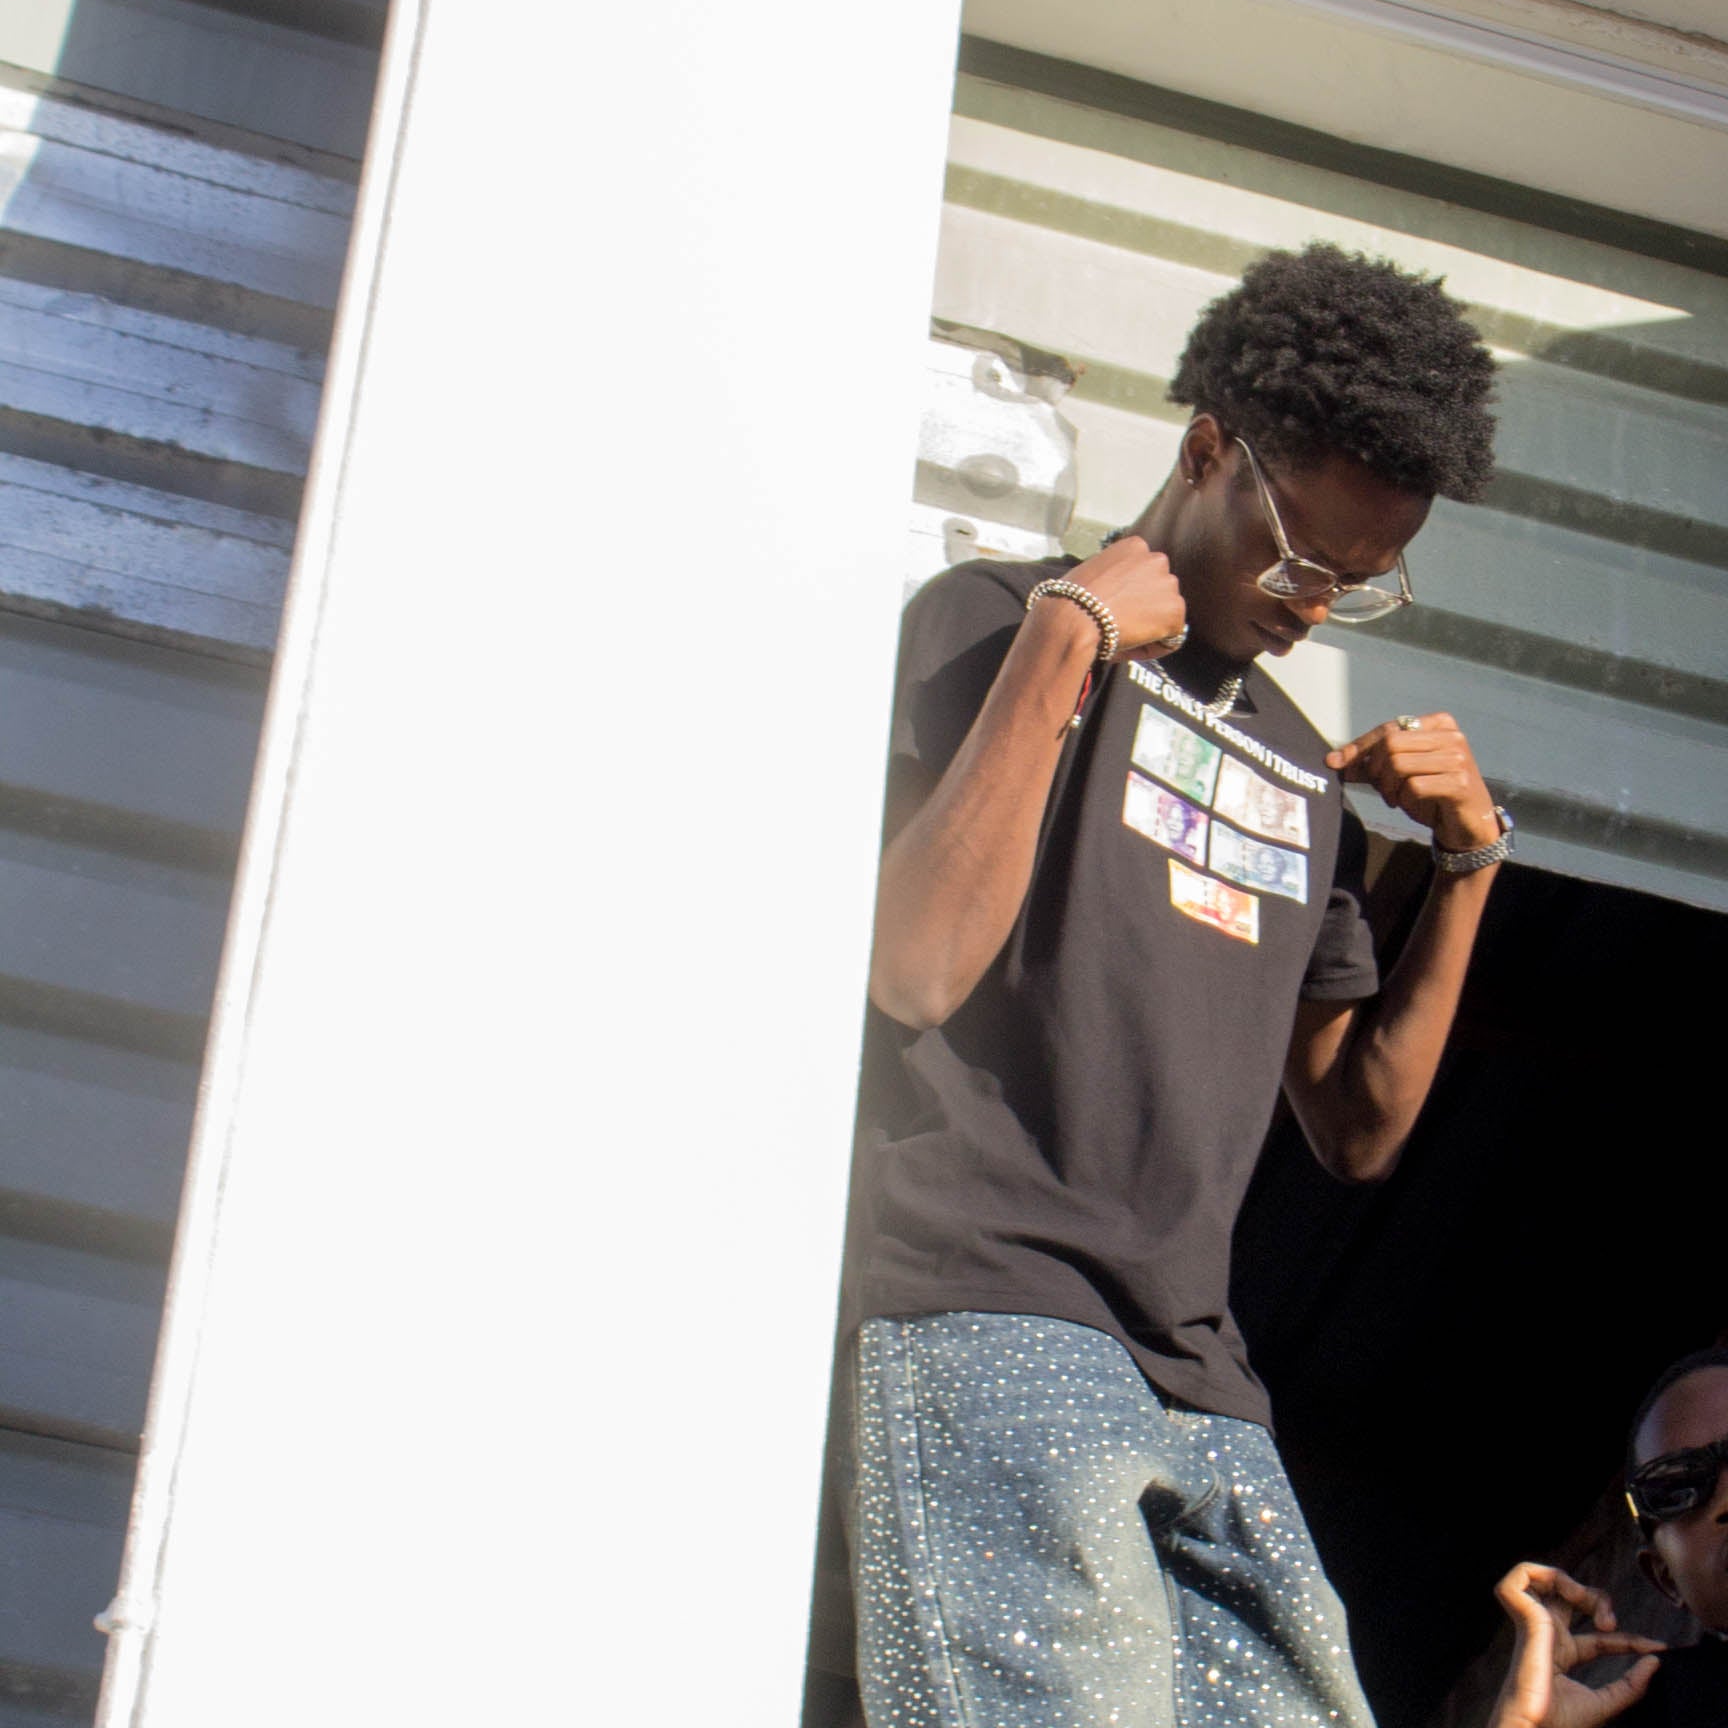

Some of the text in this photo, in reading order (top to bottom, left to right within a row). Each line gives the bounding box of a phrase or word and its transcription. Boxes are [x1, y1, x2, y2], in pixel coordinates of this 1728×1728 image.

[1128, 659, 1163, 696] THE
[1162, 683, 1204, 721] ONLY
[1271, 754, 1330, 793] TRUST
